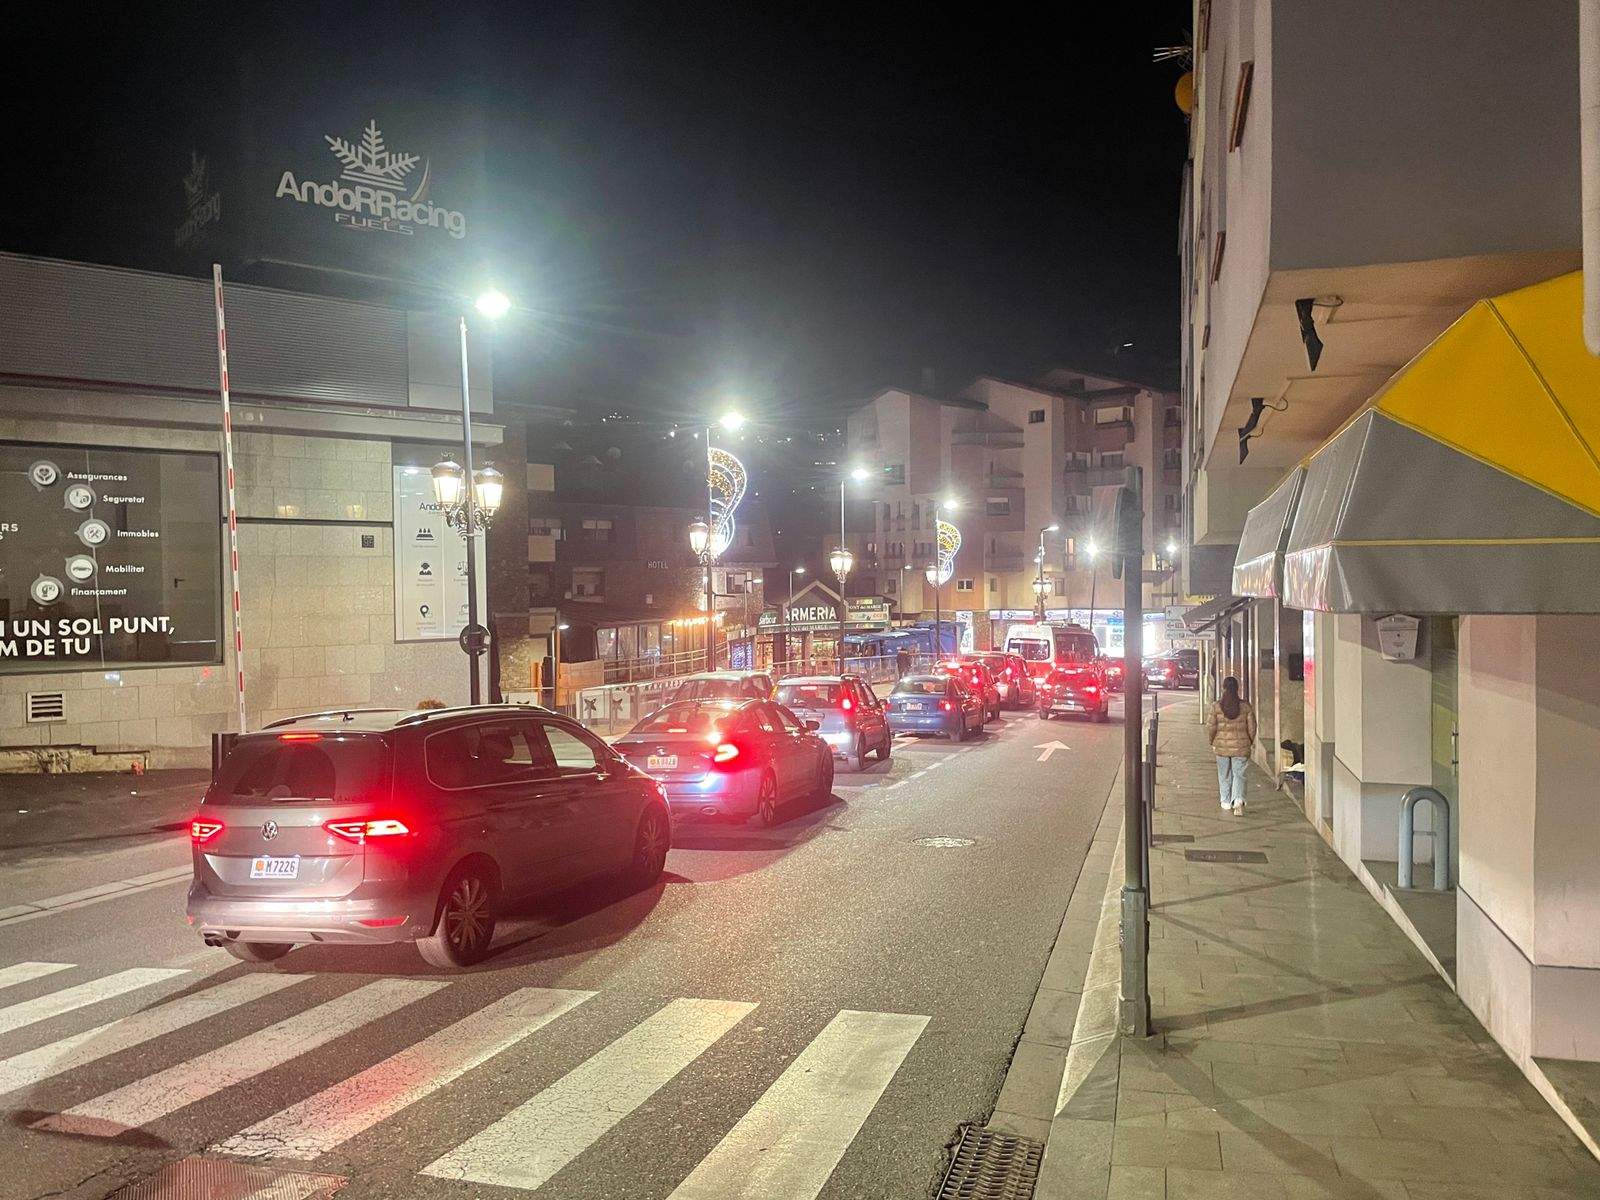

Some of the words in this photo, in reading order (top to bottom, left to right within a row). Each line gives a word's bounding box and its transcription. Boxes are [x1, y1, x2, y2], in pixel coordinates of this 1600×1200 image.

[275, 171, 466, 239] AndoRRacing
[334, 212, 414, 236] FUELS
[67, 471, 128, 482] Assegurances
[102, 494, 145, 504] Seguretat
[117, 529, 160, 538] Immobles
[105, 565, 145, 573] Mobilitat
[647, 560, 669, 569] HOTEL
[71, 588, 128, 597] Finançament
[13, 619, 51, 637] UN
[58, 618, 104, 636] SOL
[109, 616, 175, 635] PUNT,
[26, 639, 56, 656] DE
[61, 638, 91, 655] TU
